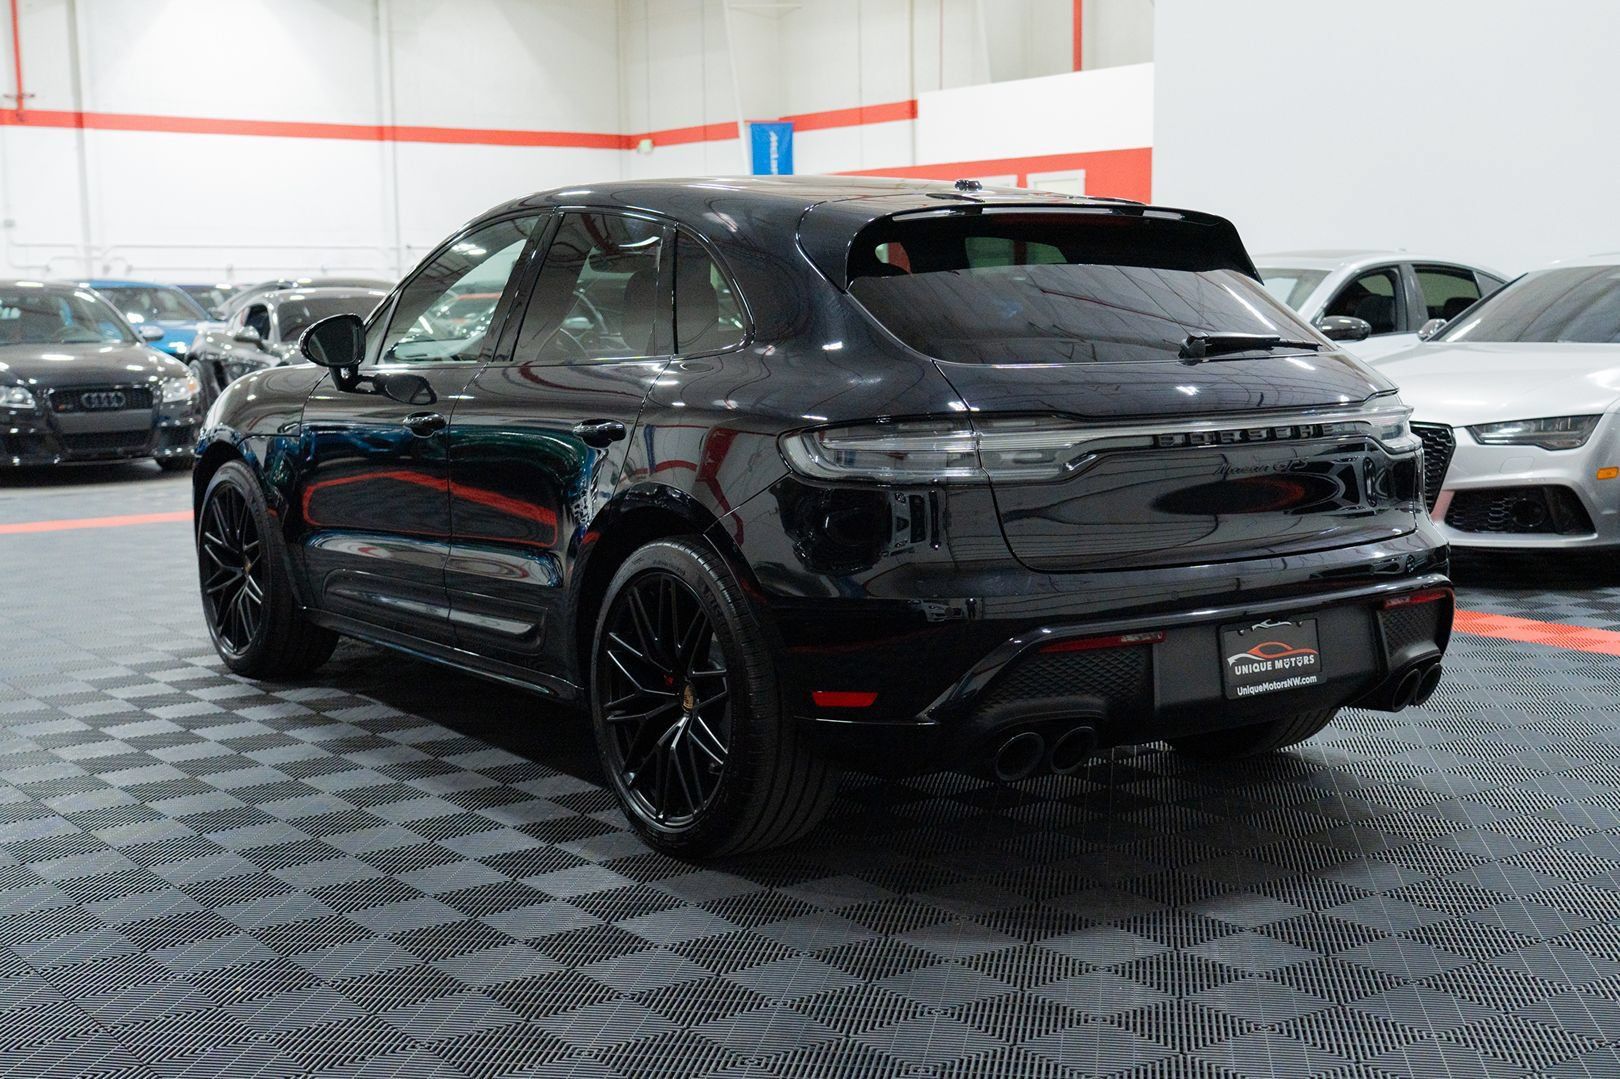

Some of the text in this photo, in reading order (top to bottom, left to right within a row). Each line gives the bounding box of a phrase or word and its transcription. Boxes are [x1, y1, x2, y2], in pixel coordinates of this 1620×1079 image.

[1154, 423, 1335, 449] PORSCHE
[1234, 654, 1315, 676] UNIQUE MOTORS
[1237, 675, 1318, 696] UniqueMotorsNW.com
